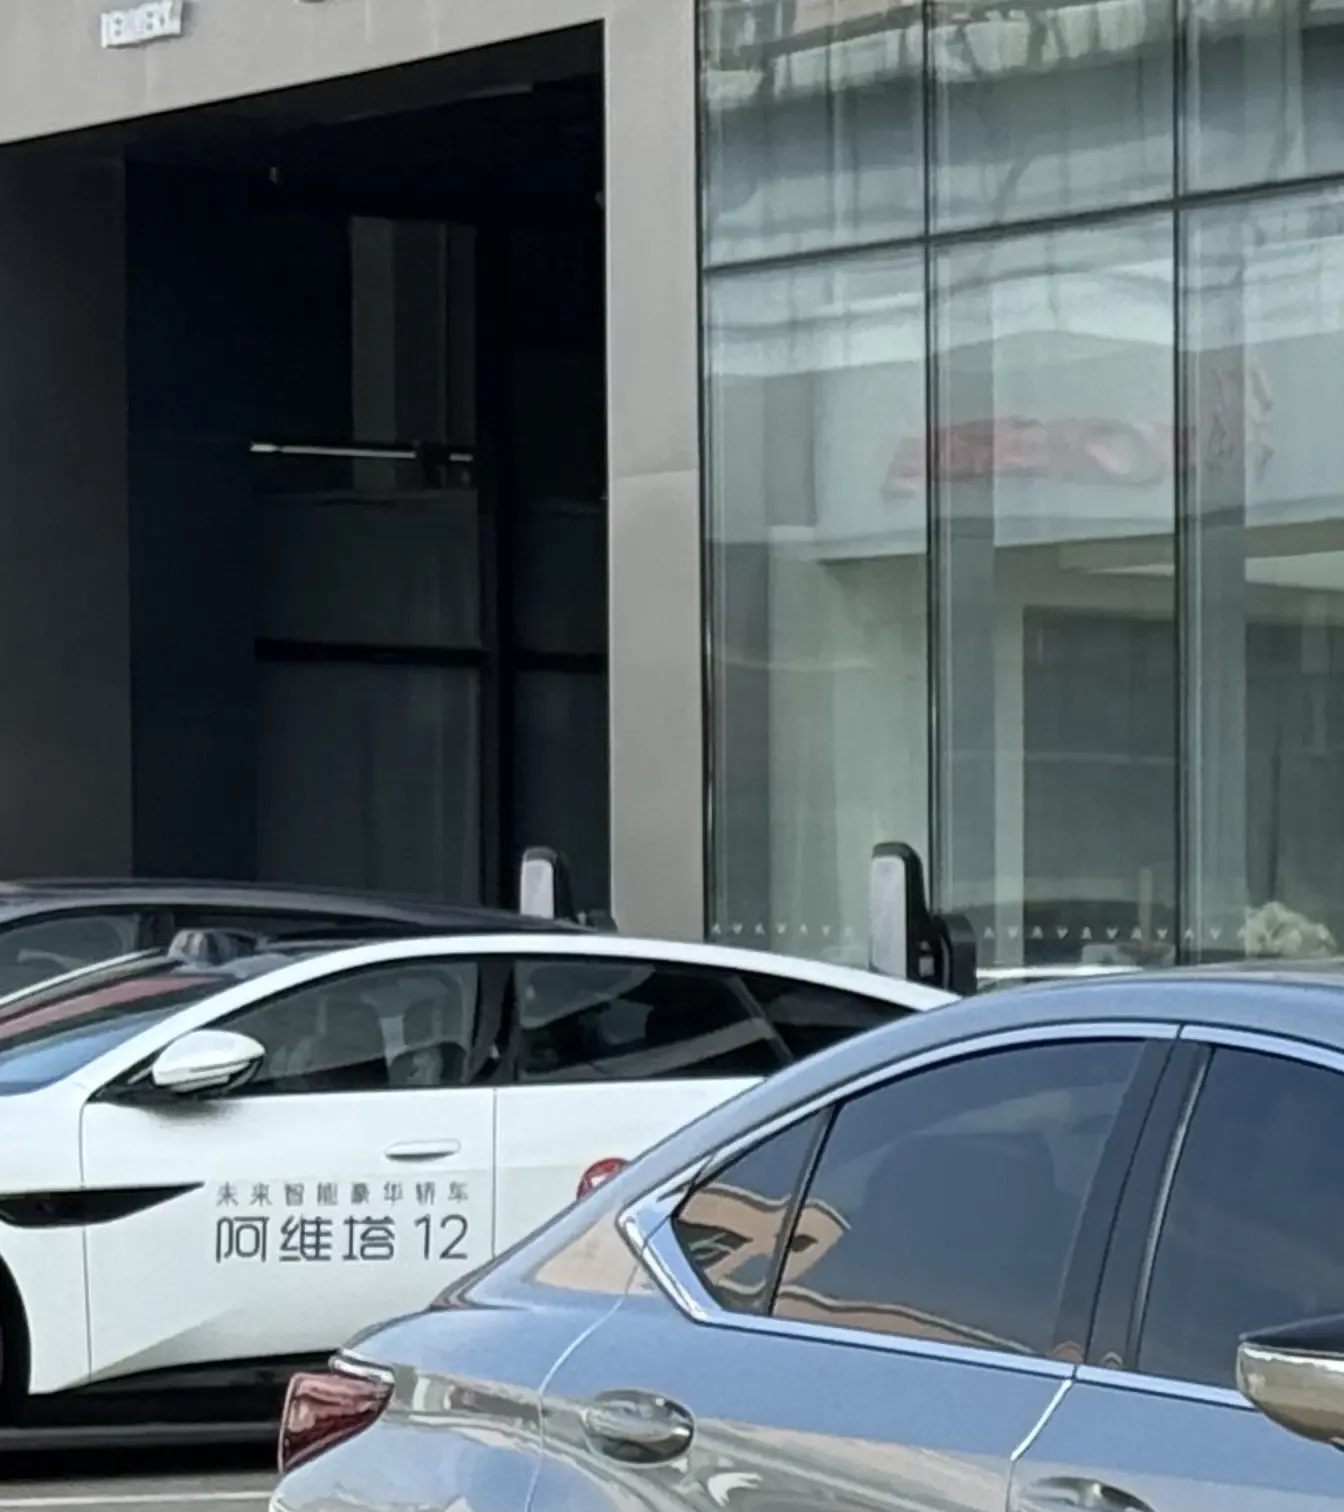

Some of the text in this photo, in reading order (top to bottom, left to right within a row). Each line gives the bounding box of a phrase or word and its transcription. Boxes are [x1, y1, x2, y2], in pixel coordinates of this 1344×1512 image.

[216, 1180, 470, 1207] 未来智能豪华轿车
[216, 1213, 469, 1263] 阿维塔 12
